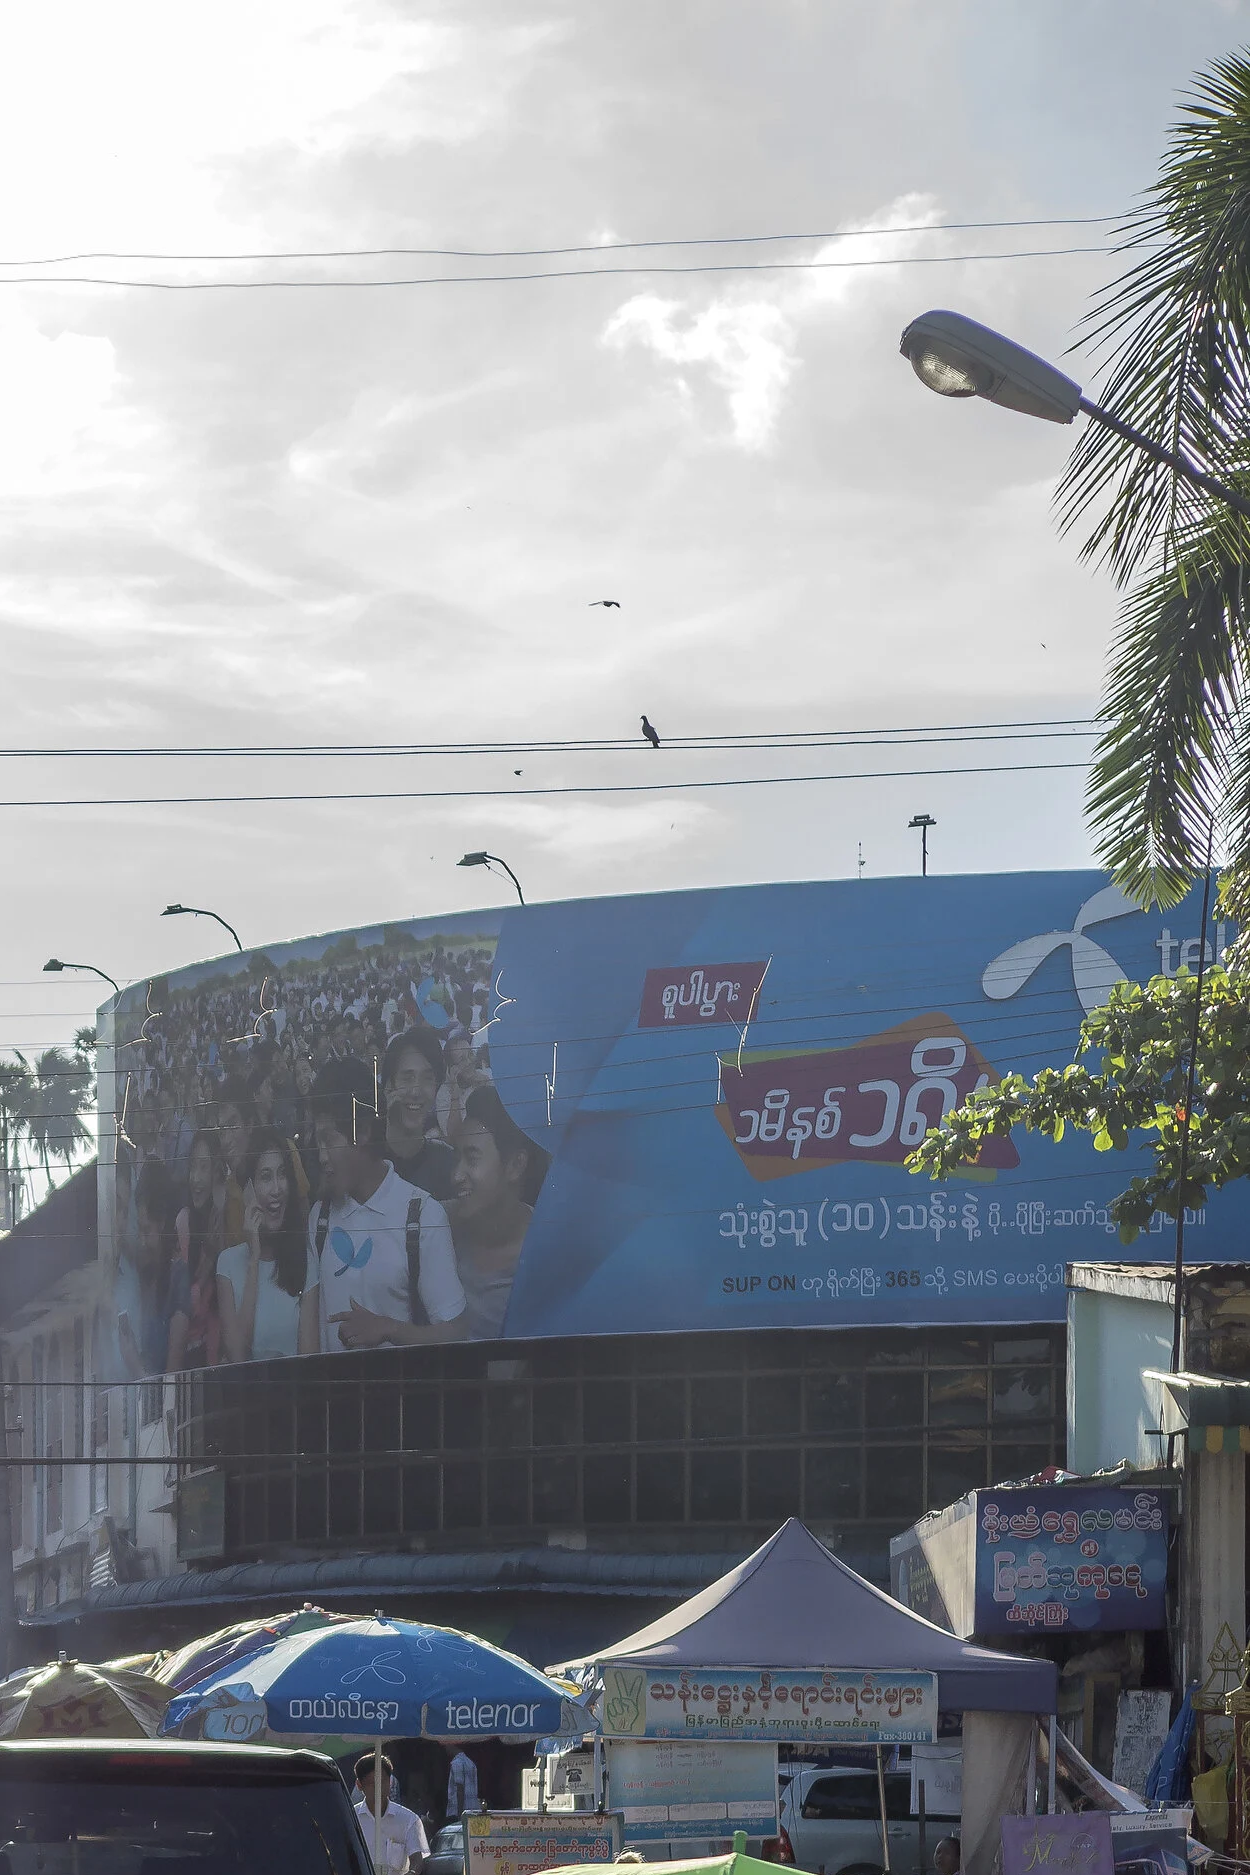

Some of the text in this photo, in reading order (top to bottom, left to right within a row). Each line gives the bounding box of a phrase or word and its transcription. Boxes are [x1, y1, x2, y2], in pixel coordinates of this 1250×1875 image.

[1156, 923, 1226, 979] tel
[722, 1275, 762, 1294] SUP
[767, 1274, 796, 1292] ON
[885, 1269, 921, 1289] 365
[953, 1268, 998, 1288] SMS
[288, 1692, 400, 1730] တယ်လီနော
[445, 1698, 541, 1730] telenor
